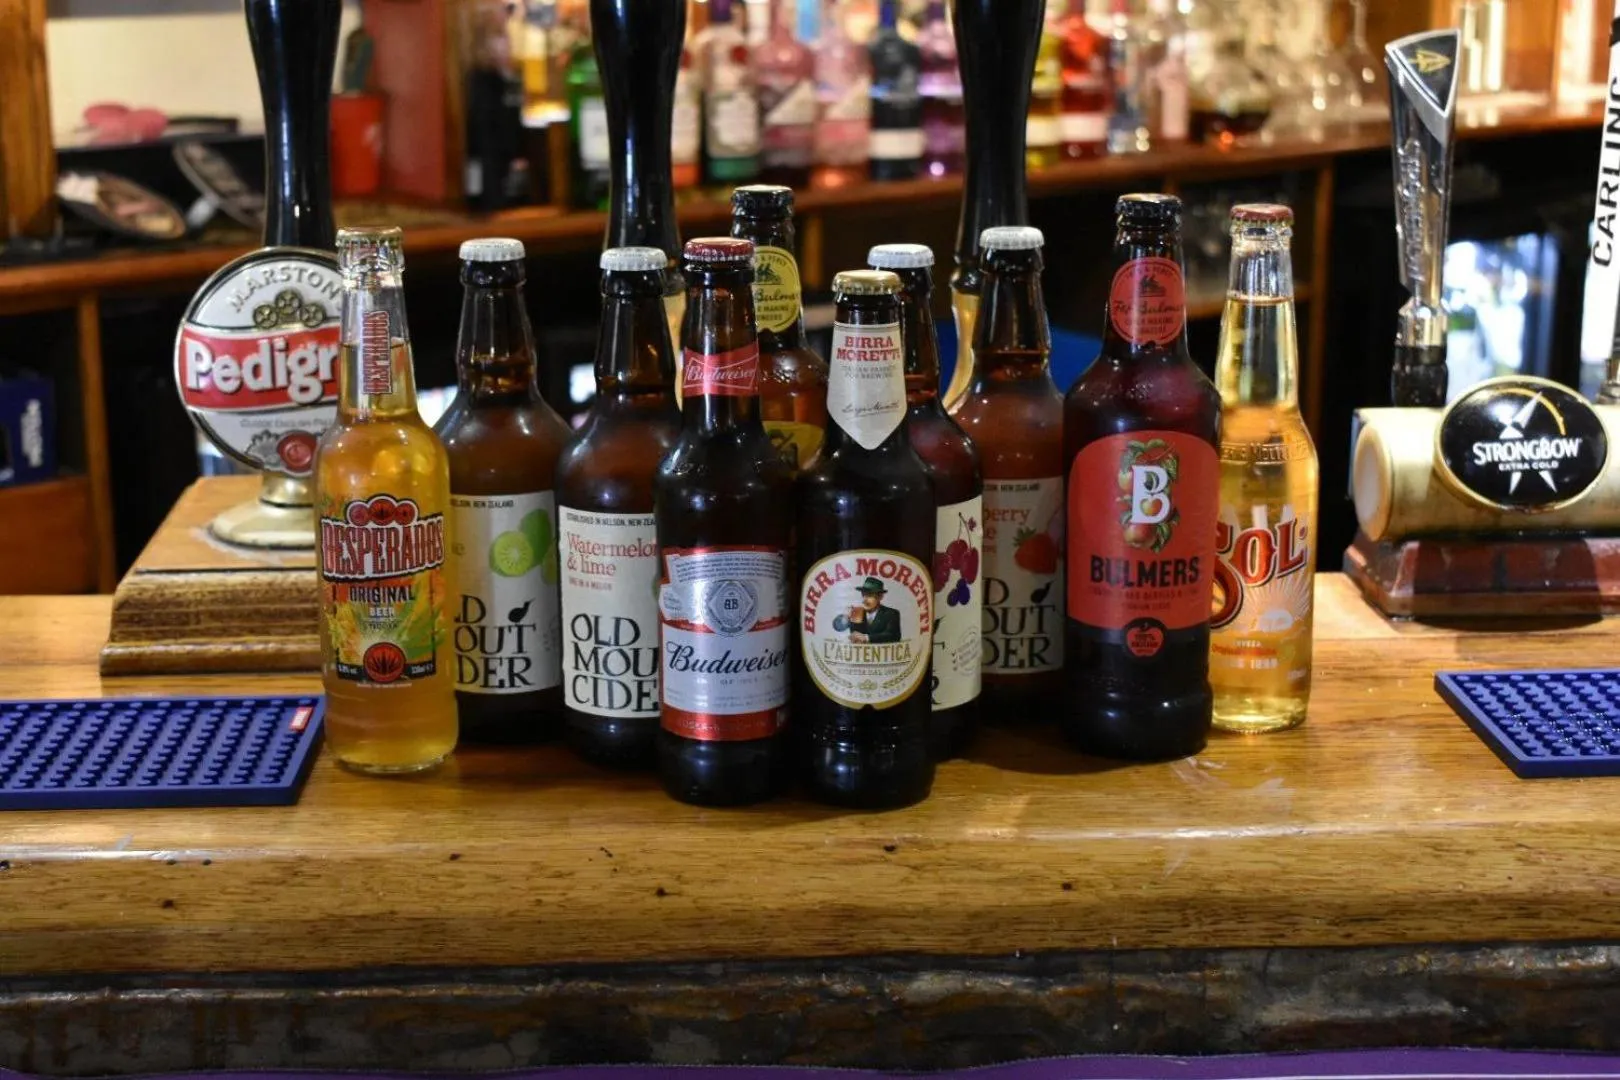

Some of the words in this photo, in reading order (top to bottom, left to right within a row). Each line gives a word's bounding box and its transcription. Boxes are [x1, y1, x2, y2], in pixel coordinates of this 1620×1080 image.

[836, 347, 901, 361] MORETTI
[844, 335, 894, 348] BIRRA
[686, 364, 755, 381] Budweiser
[1472, 437, 1580, 465] STRONGBOW
[1498, 461, 1530, 471] EXTRA
[1531, 460, 1560, 470] COLD
[1130, 465, 1170, 524] B
[322, 518, 444, 576] DESPERADOS
[567, 553, 577, 571] &
[580, 554, 617, 576] lime
[1090, 555, 1200, 588] BULMERS
[350, 585, 415, 603] ORIGINAL
[803, 563, 852, 635] BIRRA
[855, 557, 931, 636] MORETTI
[369, 607, 395, 617] BEER
[570, 613, 641, 647] OLD
[570, 641, 659, 677] MOU
[666, 641, 788, 673] Budweiser
[824, 642, 912, 662] L'AUTENTICA
[572, 674, 659, 712] CIDE
